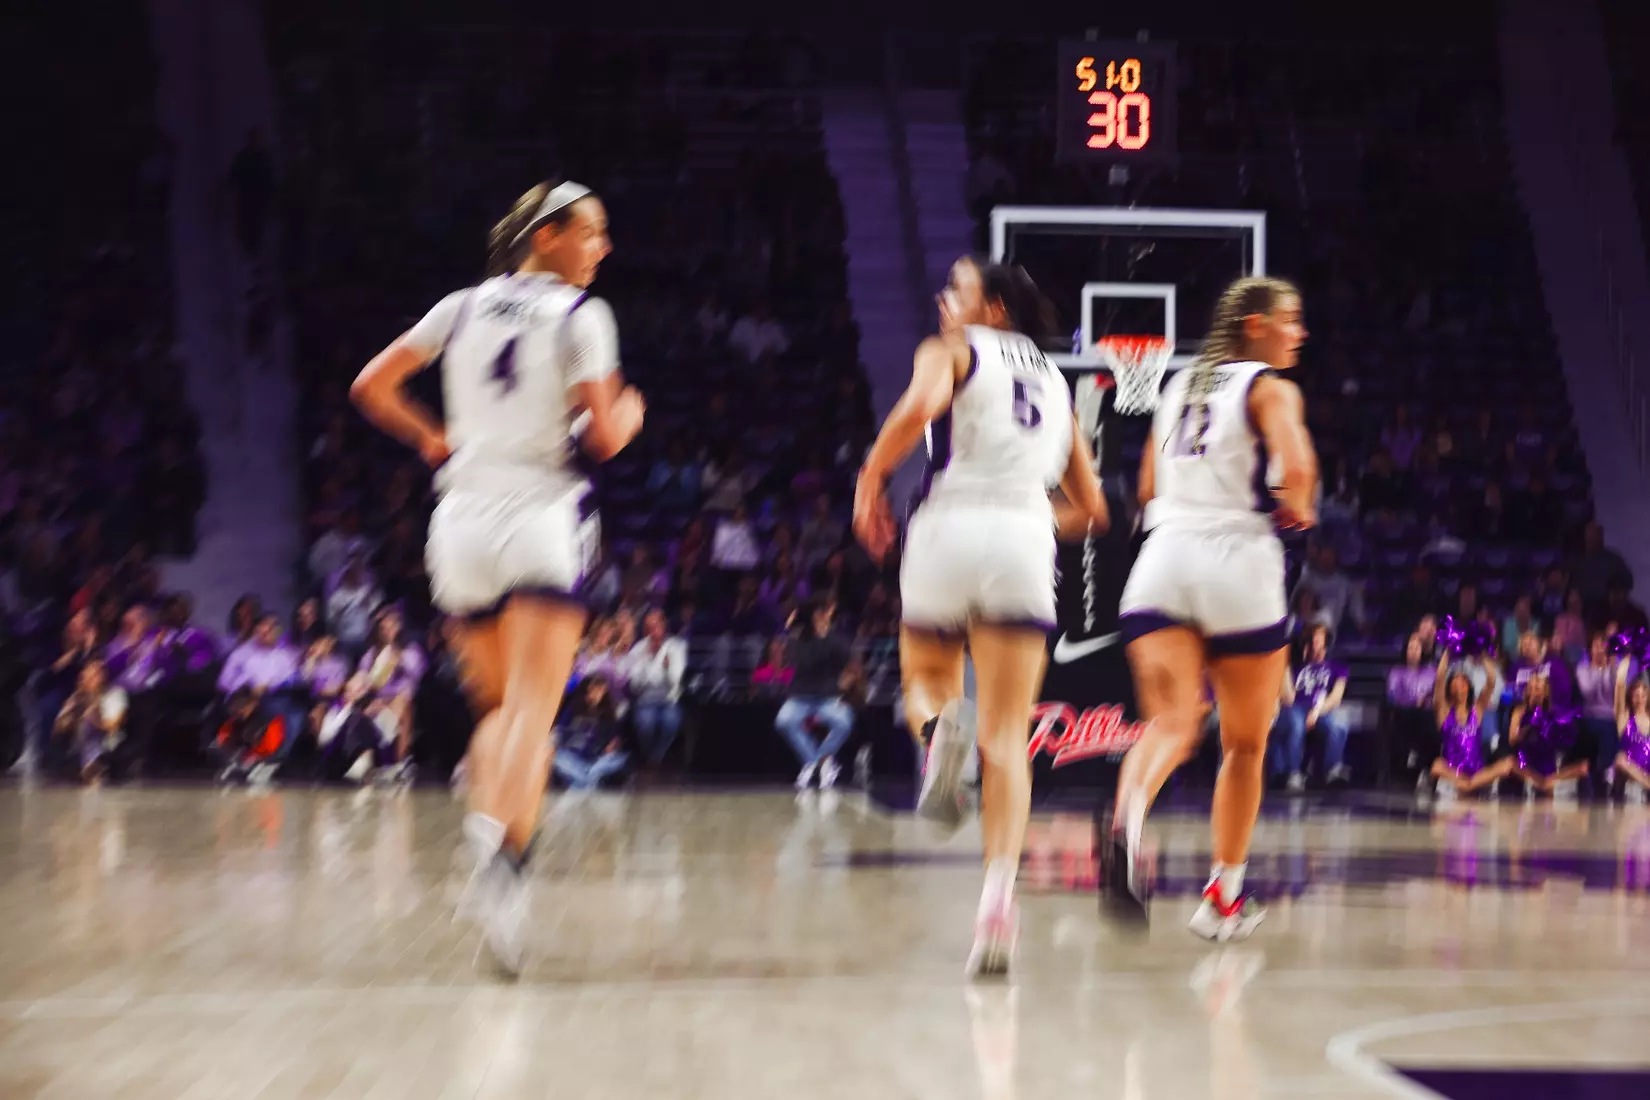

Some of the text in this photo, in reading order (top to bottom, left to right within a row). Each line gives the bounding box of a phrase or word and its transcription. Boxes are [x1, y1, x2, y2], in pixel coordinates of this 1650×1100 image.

[1086, 90, 1150, 150] 30
[488, 335, 521, 398] 4
[1011, 375, 1044, 430] 5
